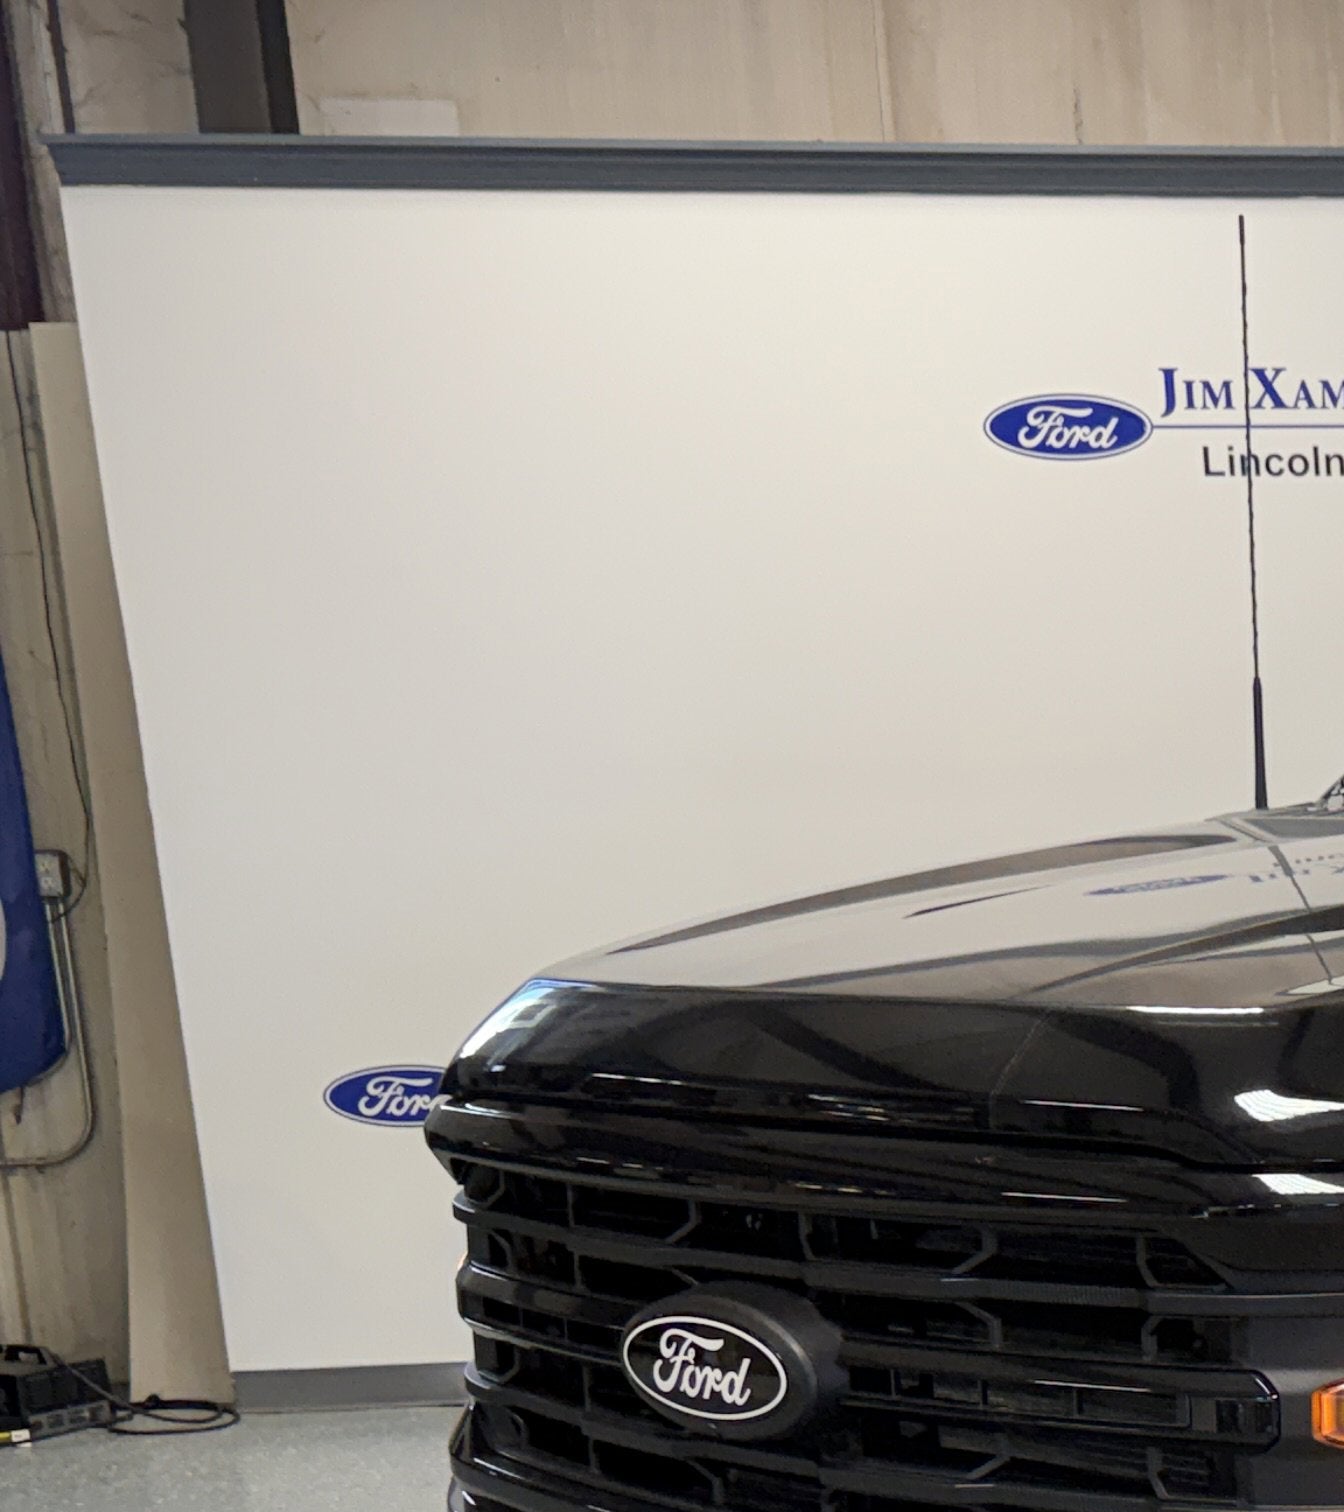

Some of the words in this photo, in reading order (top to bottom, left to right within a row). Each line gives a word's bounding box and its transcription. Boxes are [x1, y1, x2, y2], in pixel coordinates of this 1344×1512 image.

[1158, 367, 1234, 418] JIM
[1017, 406, 1118, 450] Ford
[358, 1075, 453, 1117] For
[652, 1327, 751, 1407] Ford
